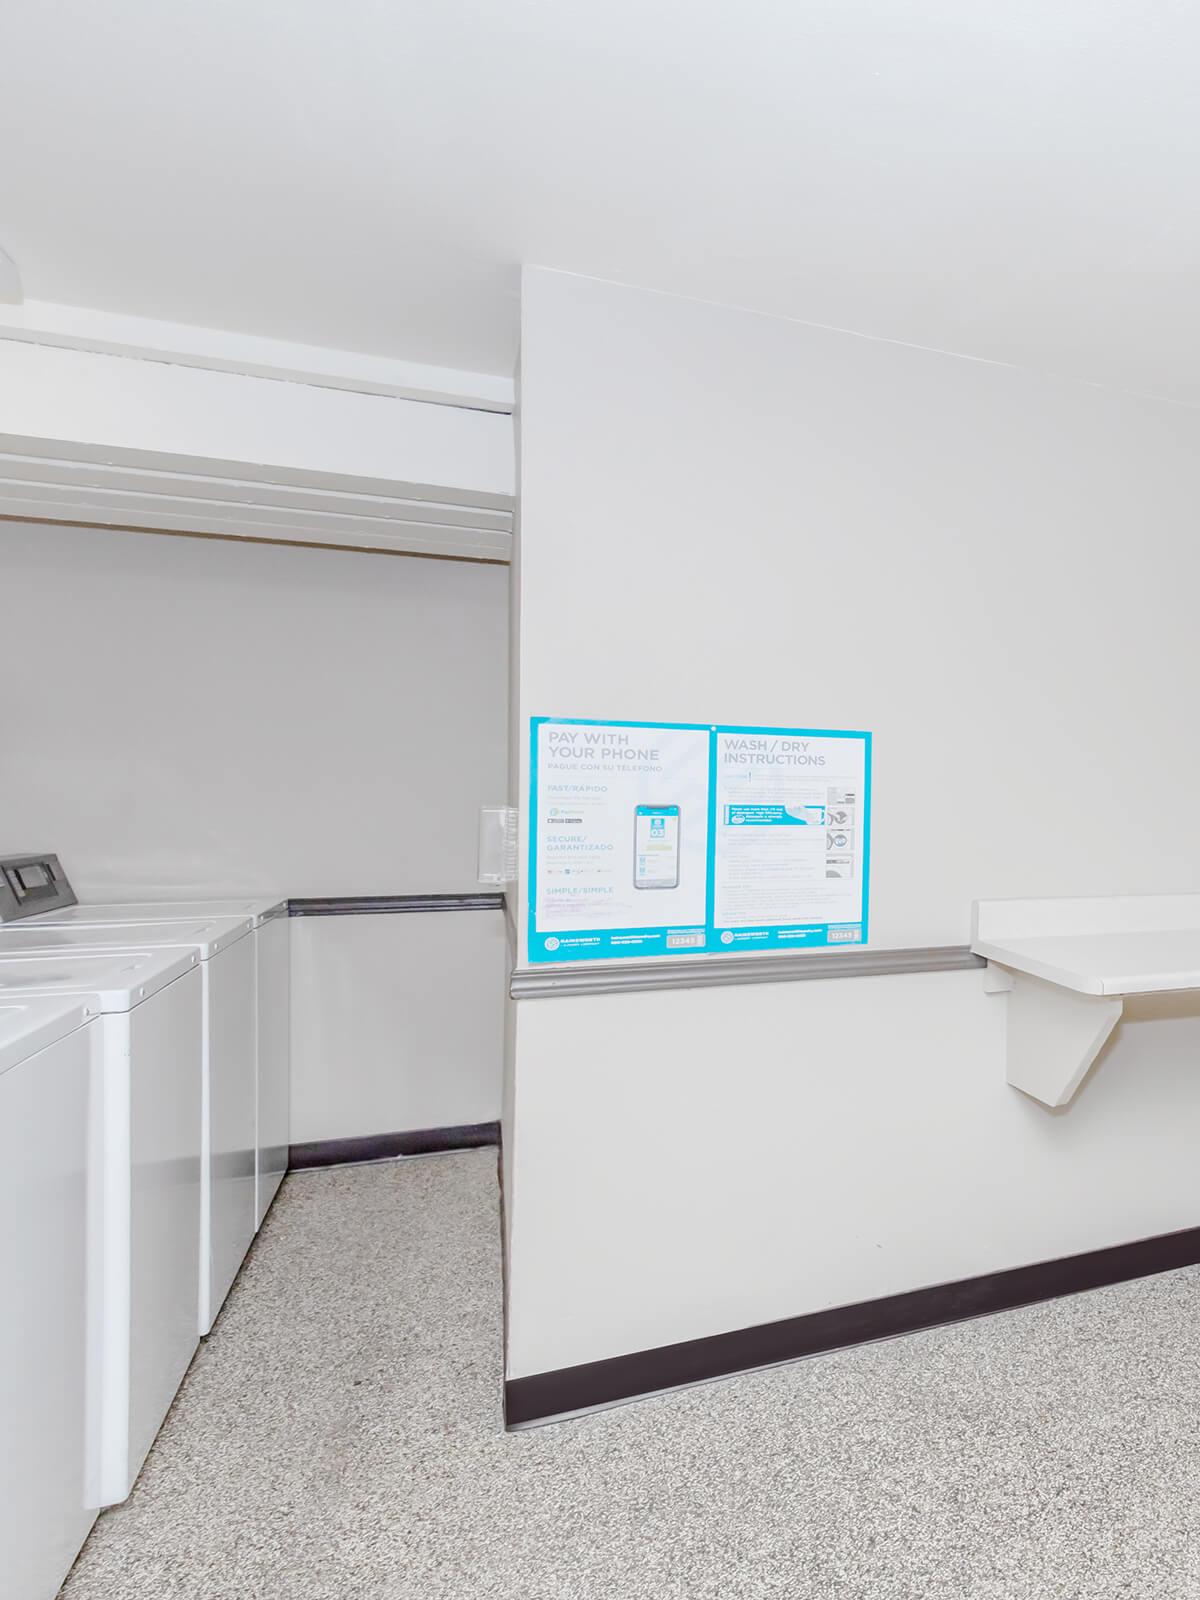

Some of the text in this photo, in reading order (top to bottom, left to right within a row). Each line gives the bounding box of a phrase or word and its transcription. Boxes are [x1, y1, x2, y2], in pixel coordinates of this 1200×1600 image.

[548, 731, 629, 746] PAY WITH
[724, 739, 810, 753] WASH / DRY
[548, 746, 660, 761] YOUR PHONE
[724, 753, 826, 766] INSTRUCTIONS
